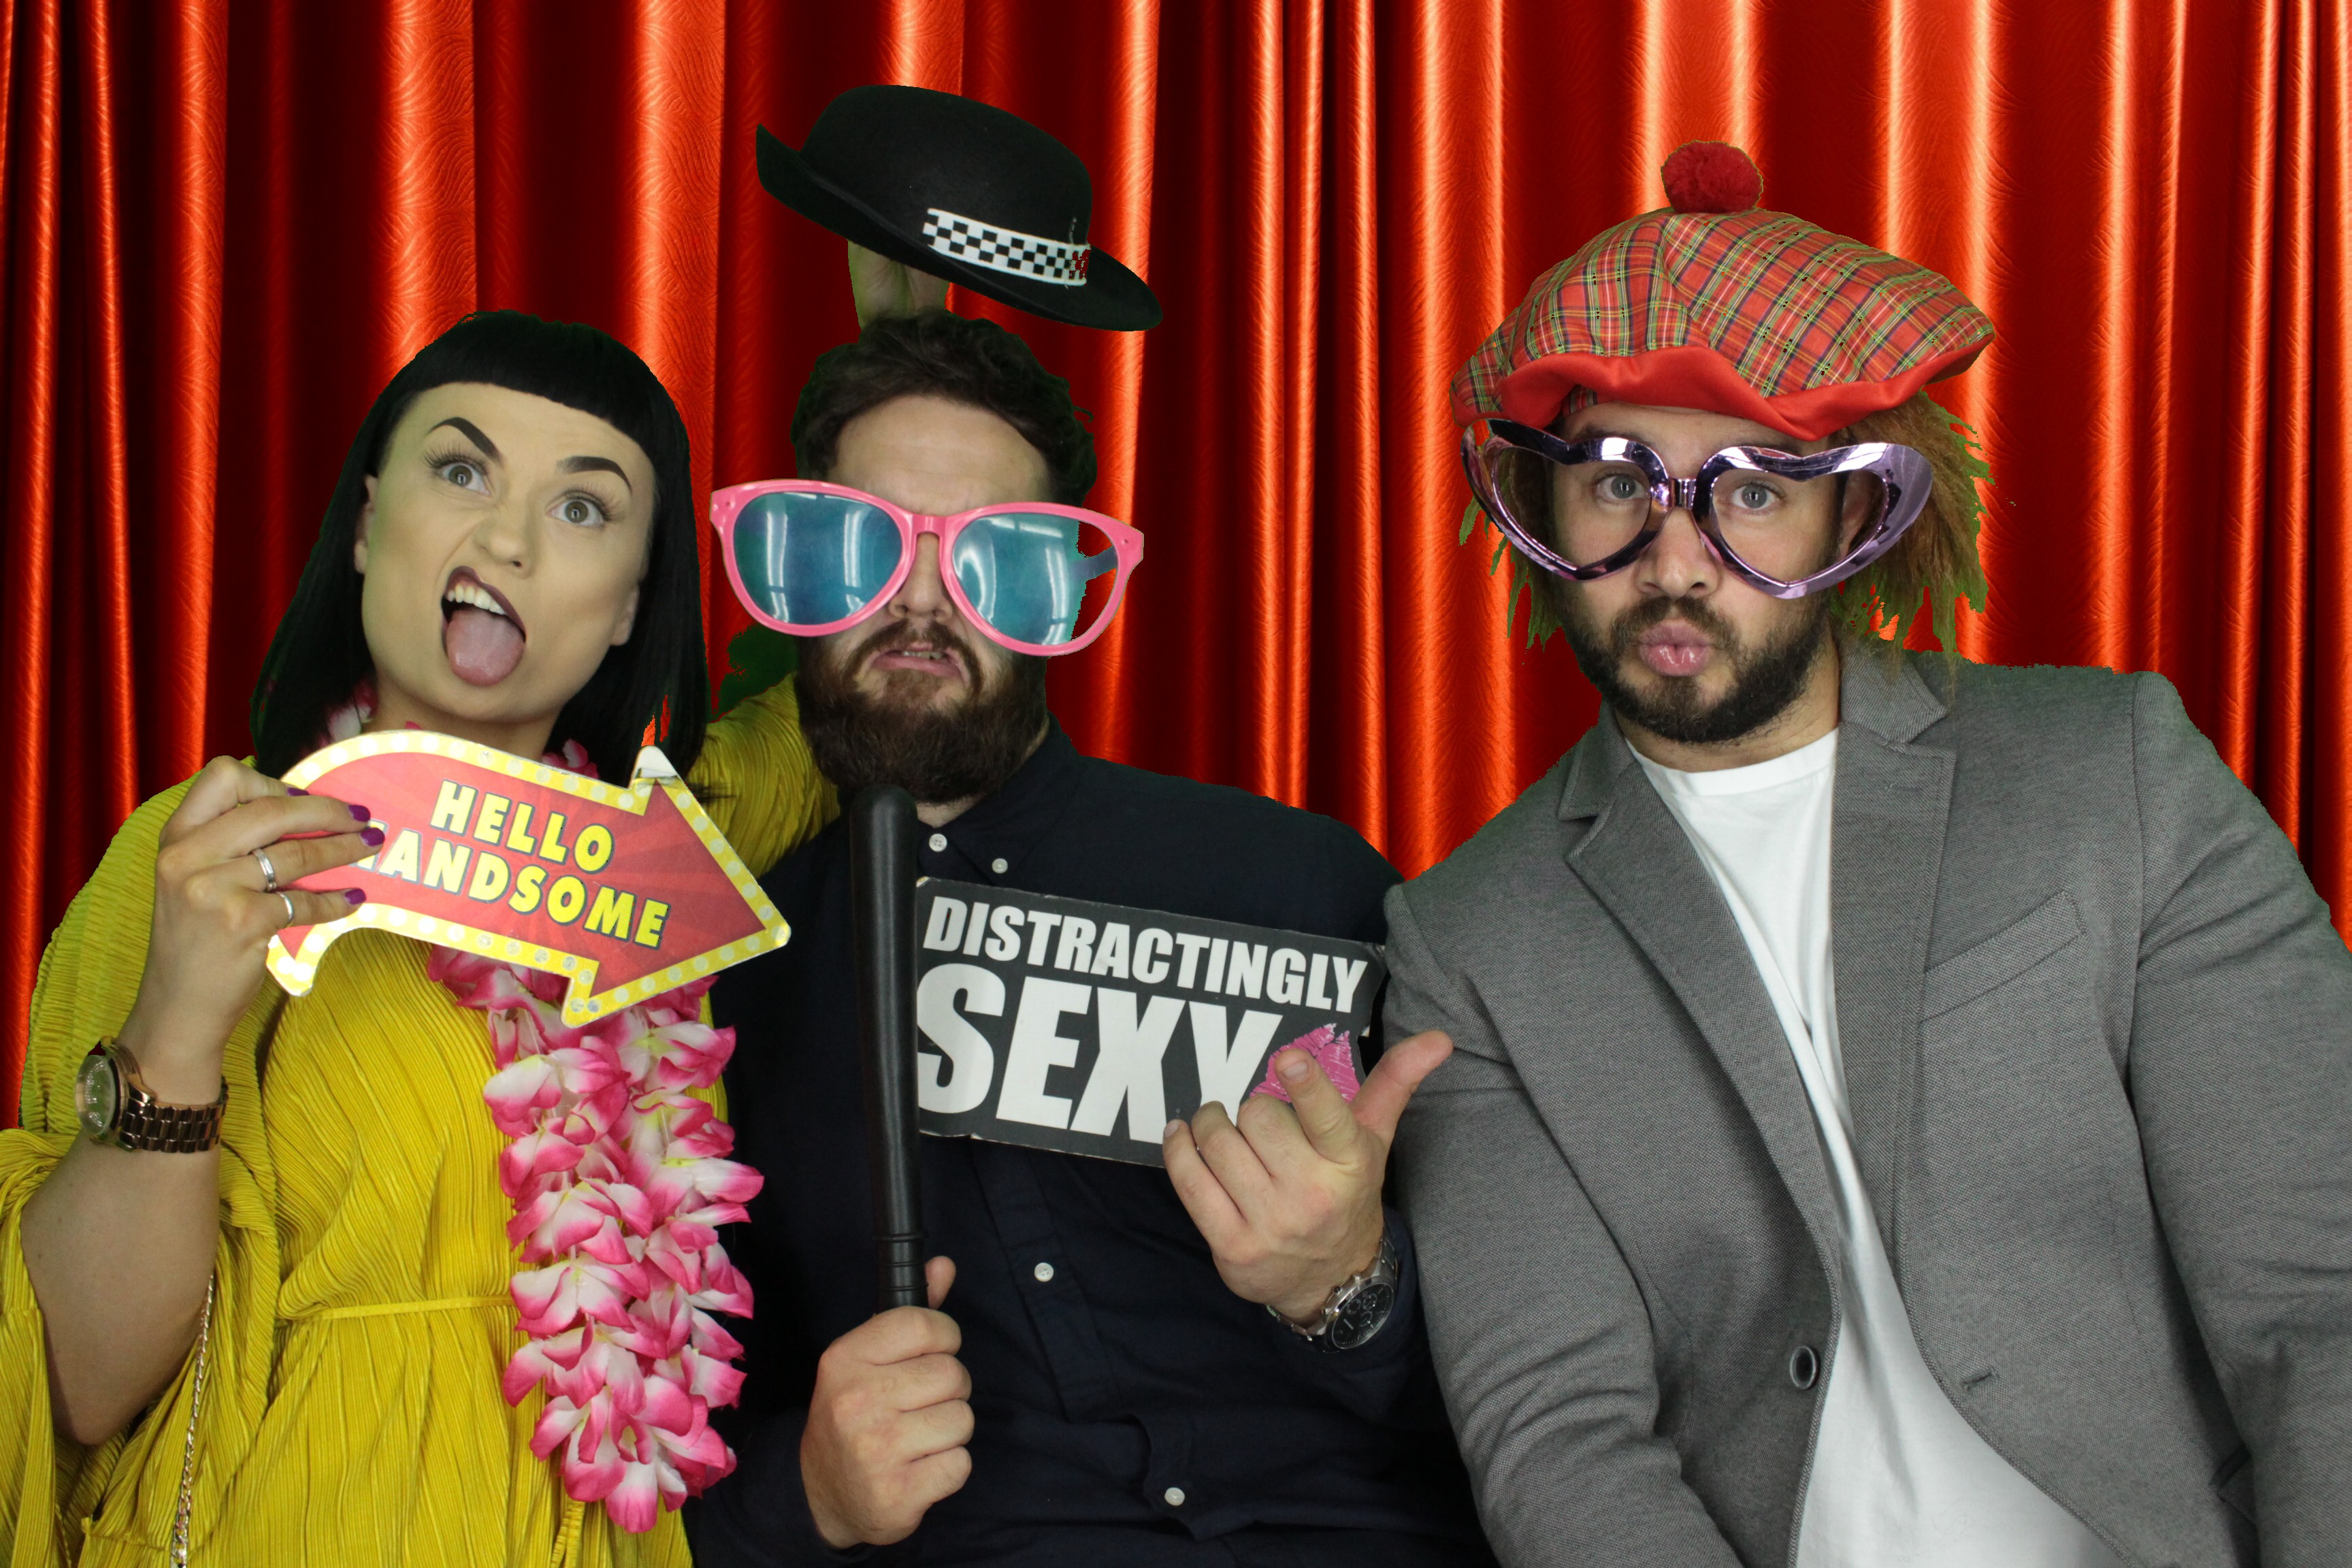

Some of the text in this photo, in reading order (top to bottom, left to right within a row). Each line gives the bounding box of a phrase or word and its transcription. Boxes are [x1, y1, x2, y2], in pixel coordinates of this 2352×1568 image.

[348, 819, 670, 949] ANDSOME
[430, 779, 614, 873] HELLO
[923, 896, 1368, 1013] DISTRACTINGLY
[916, 964, 1283, 1145] SEXY
